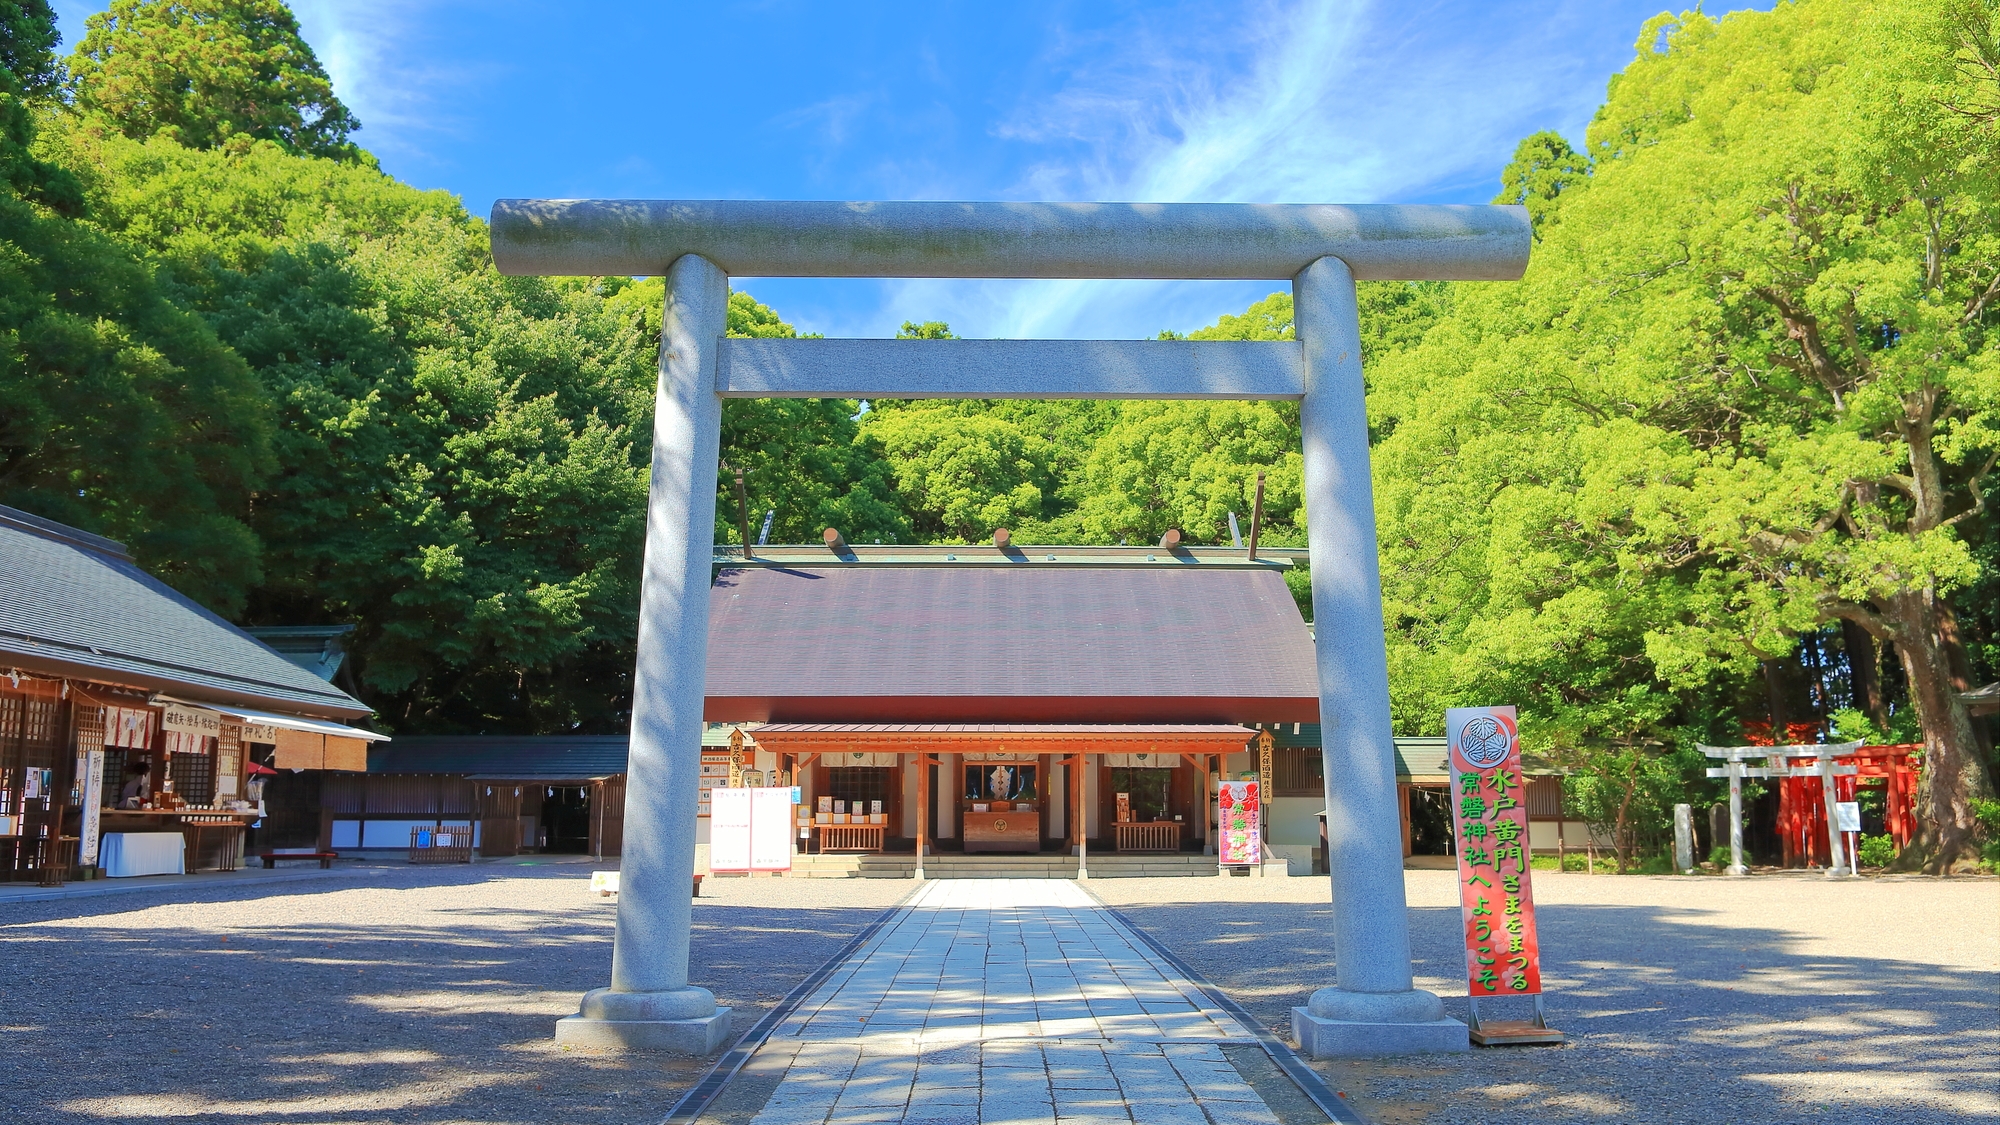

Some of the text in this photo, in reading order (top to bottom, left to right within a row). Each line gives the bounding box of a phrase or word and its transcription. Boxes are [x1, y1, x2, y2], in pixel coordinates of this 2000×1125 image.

[1231, 803, 1247, 860] 常磐神社
[1458, 771, 1499, 991] 常磐神社へようこそ
[1486, 767, 1529, 990] 水戸黄門さまをまつる
